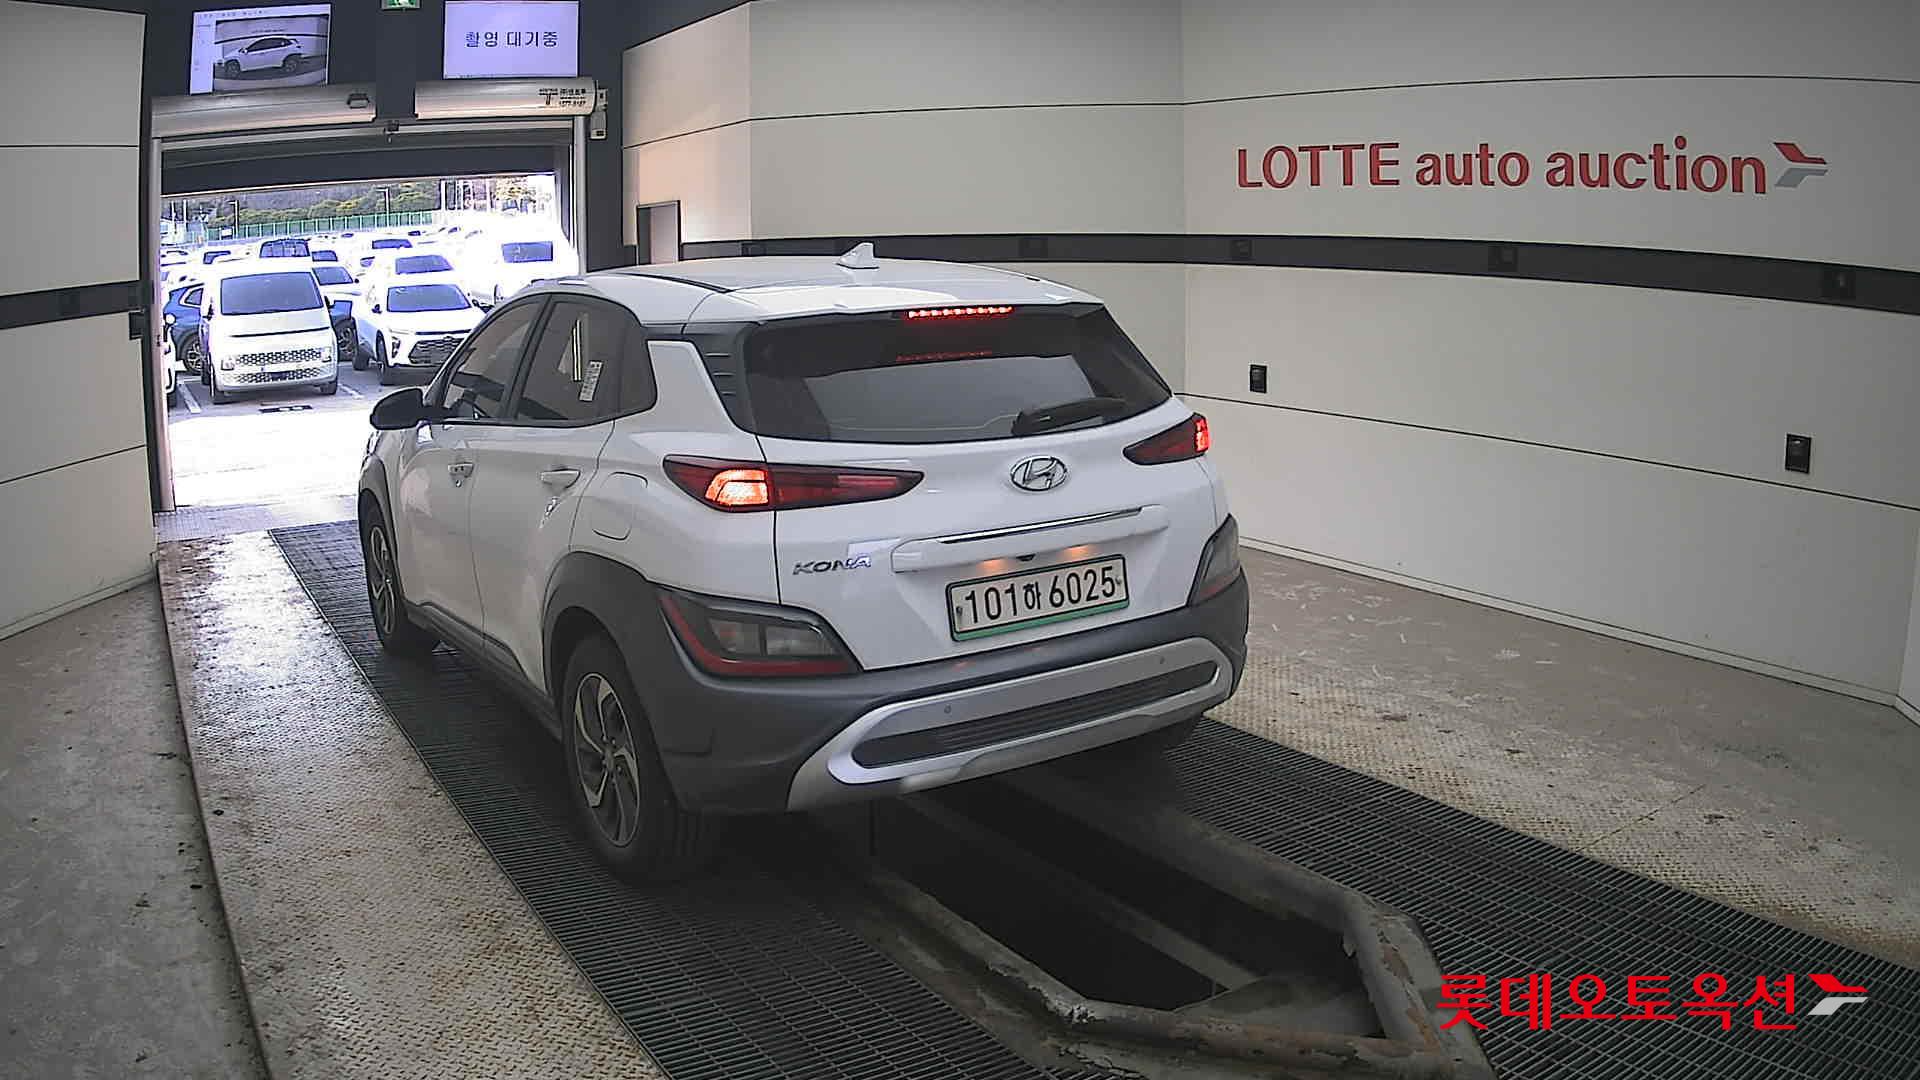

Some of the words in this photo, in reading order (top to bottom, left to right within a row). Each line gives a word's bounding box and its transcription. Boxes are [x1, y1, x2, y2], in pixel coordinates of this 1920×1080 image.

[465, 31, 498, 48] 촬영
[506, 31, 558, 48] 대기중
[1237, 142, 1400, 188] LOTTE
[1415, 143, 1530, 188] auto
[1545, 135, 1767, 195] auction
[793, 555, 872, 575] KONA
